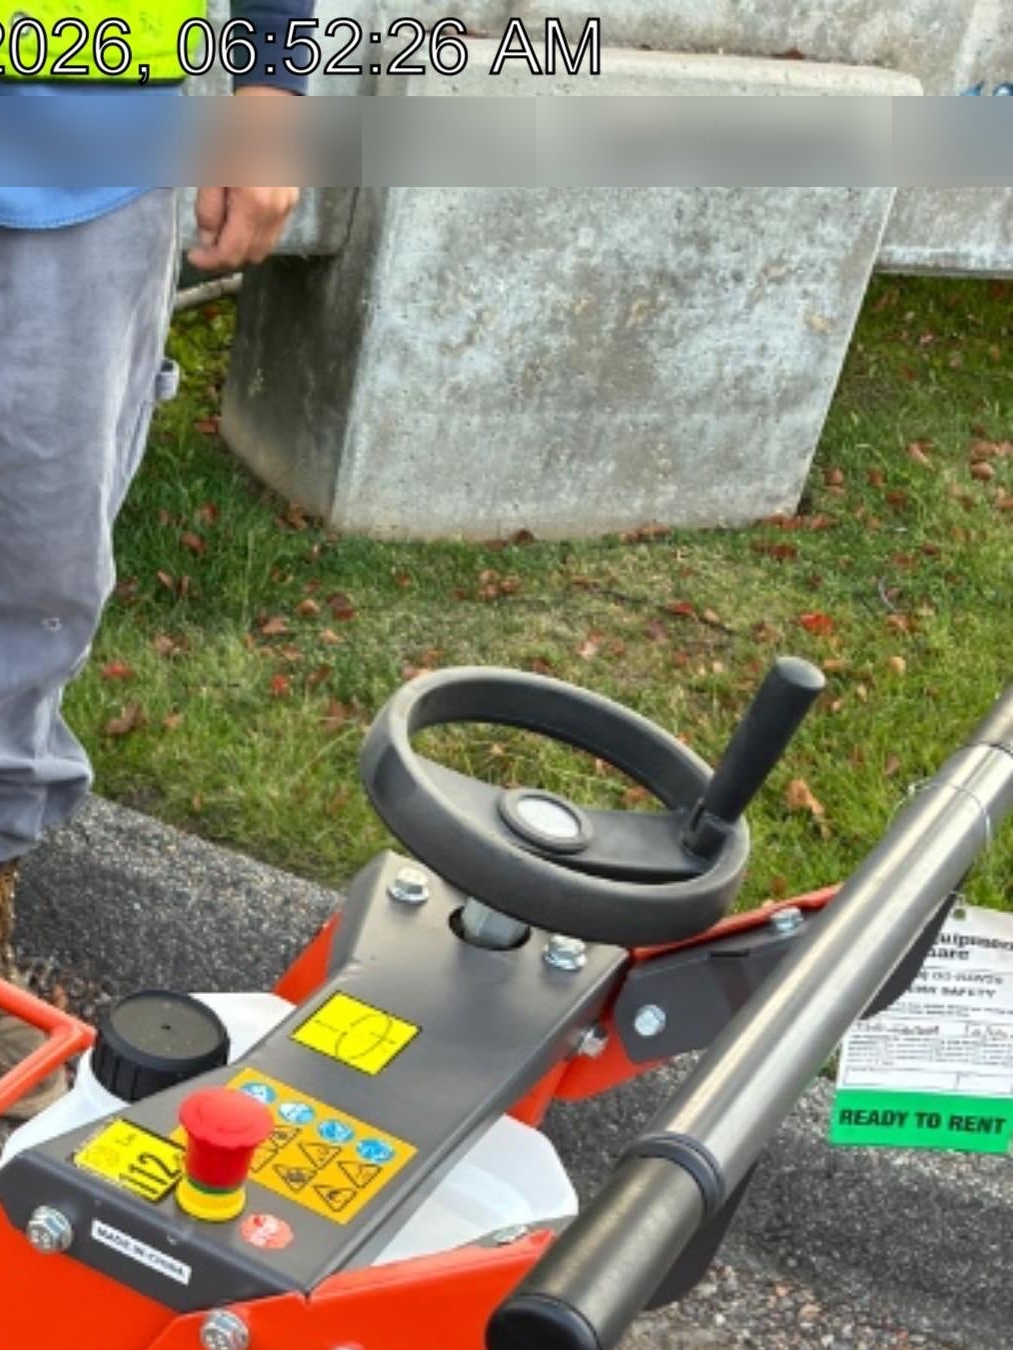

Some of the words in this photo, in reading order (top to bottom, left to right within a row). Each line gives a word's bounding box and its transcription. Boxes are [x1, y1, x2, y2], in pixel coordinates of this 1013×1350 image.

[839, 1108, 908, 1127] READY
[914, 1111, 941, 1129] TO
[948, 1114, 1006, 1134] RENT
